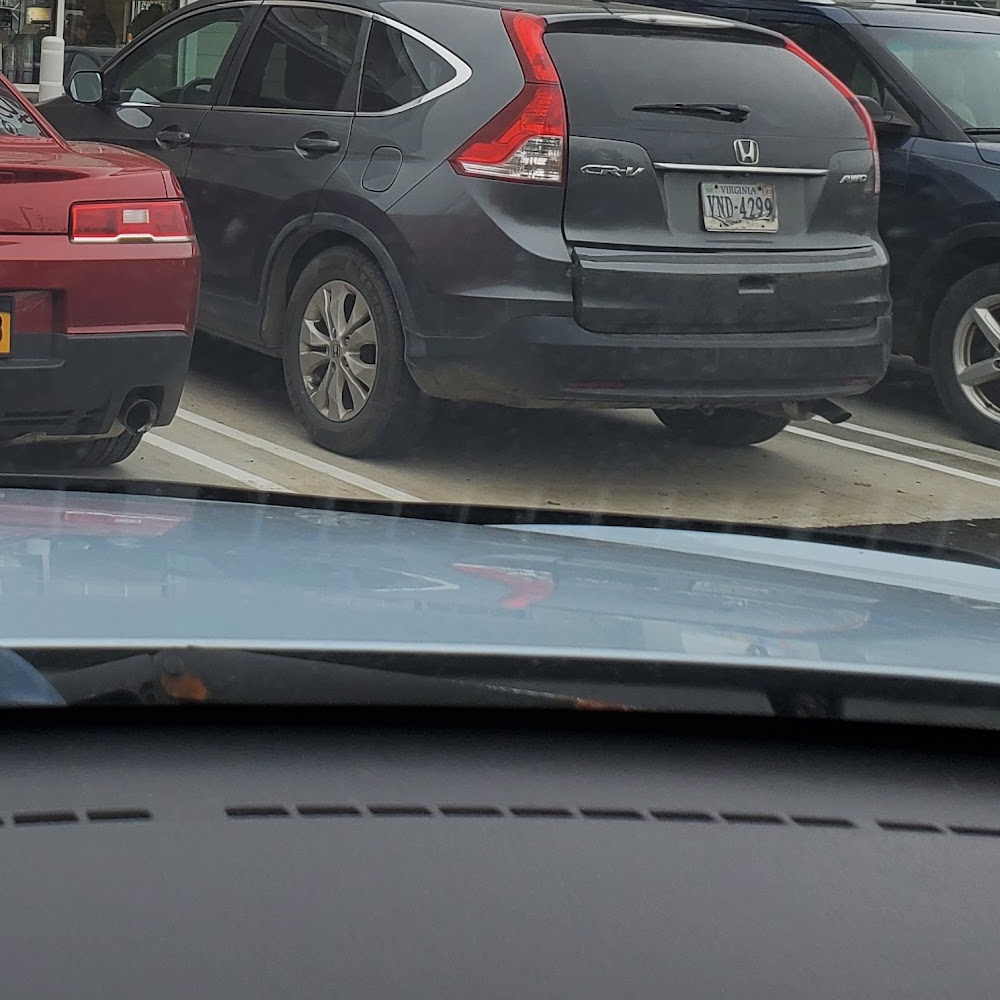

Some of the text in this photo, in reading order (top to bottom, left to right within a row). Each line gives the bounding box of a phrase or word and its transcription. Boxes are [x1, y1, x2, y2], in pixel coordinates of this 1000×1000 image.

[580, 163, 646, 178] CR-V
[839, 173, 868, 184] AWD
[720, 185, 757, 195] VIRGINIA
